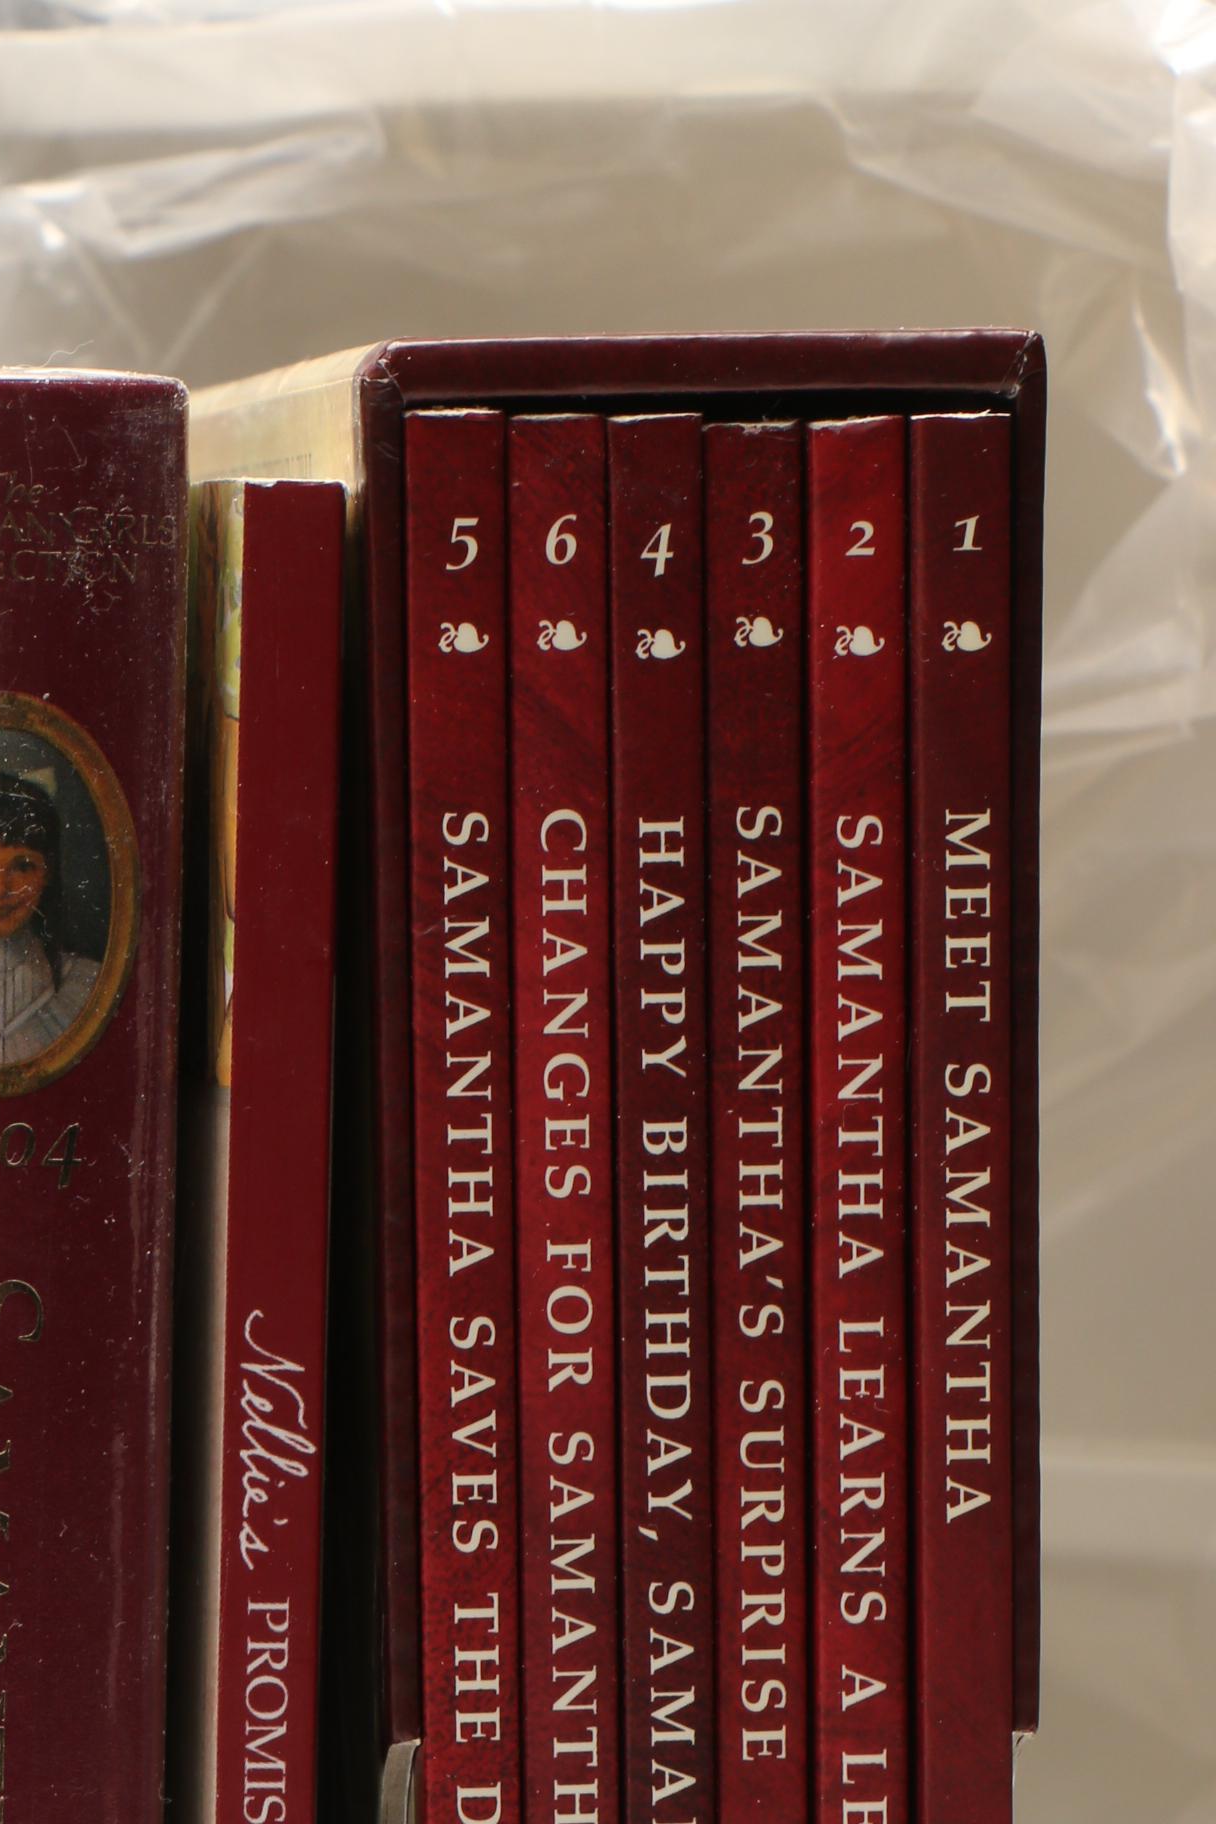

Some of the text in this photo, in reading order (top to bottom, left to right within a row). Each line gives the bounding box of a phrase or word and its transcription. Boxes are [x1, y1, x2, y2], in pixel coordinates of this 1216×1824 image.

[446, 518, 478, 570] 5
[546, 515, 576, 564] 6
[641, 524, 673, 577] 4
[742, 512, 773, 564] 3
[846, 521, 874, 556] 2
[954, 516, 981, 551] 1
[443, 813, 494, 1276] SAMANTHA
[541, 810, 591, 1198] CHANGES
[639, 816, 686, 1077] HAPPY
[837, 816, 883, 1278] SAMANTHA
[736, 807, 786, 1760] SAMANTHA'S SURPRISE
[945, 809, 991, 1523] MEET SAMANTHA
[547, 1239, 592, 1392] FOR
[639, 1117, 692, 1540] BIRTHDAY,
[239, 1310, 316, 1570] Nellie's
[450, 1317, 498, 1553] SAVES
[839, 1317, 886, 1624] LEARNS
[455, 1593, 500, 1742] THE
[842, 1665, 886, 1711] A
